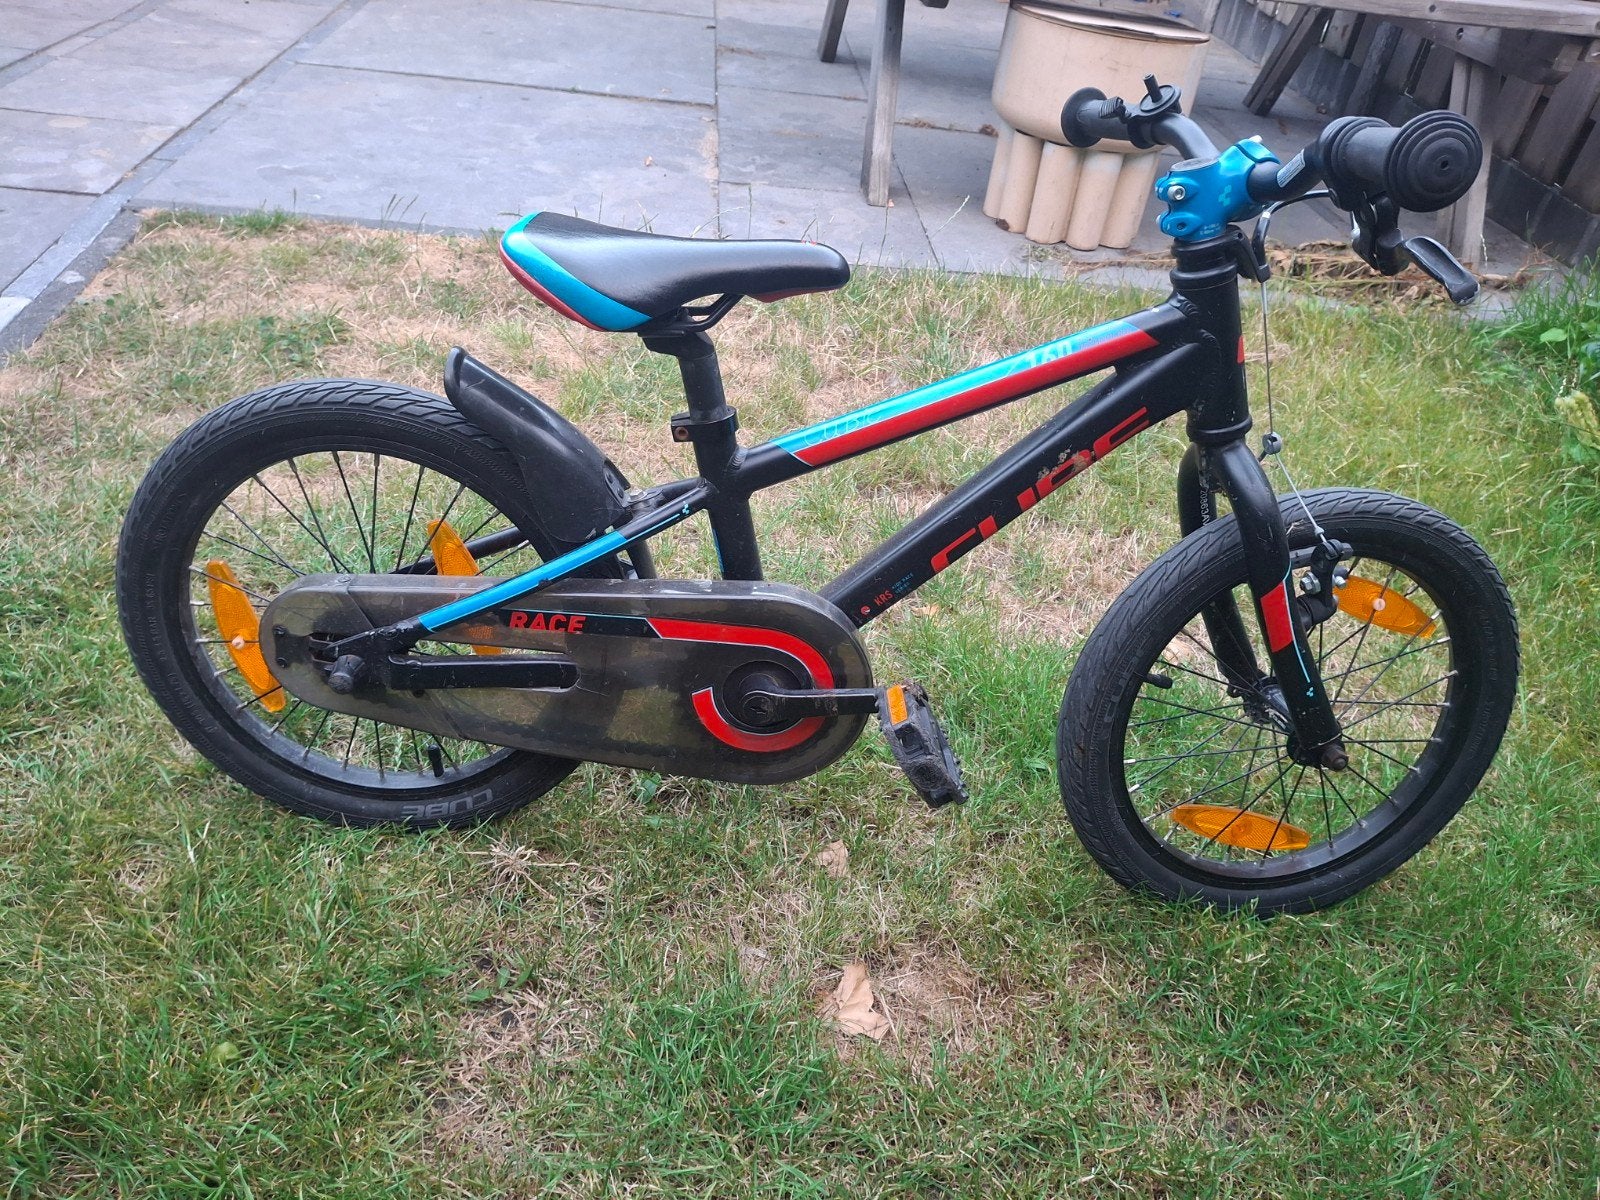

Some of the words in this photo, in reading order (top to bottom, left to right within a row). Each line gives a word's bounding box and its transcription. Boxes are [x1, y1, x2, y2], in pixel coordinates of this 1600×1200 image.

[873, 589, 895, 606] KRS
[509, 611, 587, 635] RACE
[400, 787, 495, 820] CUBE
